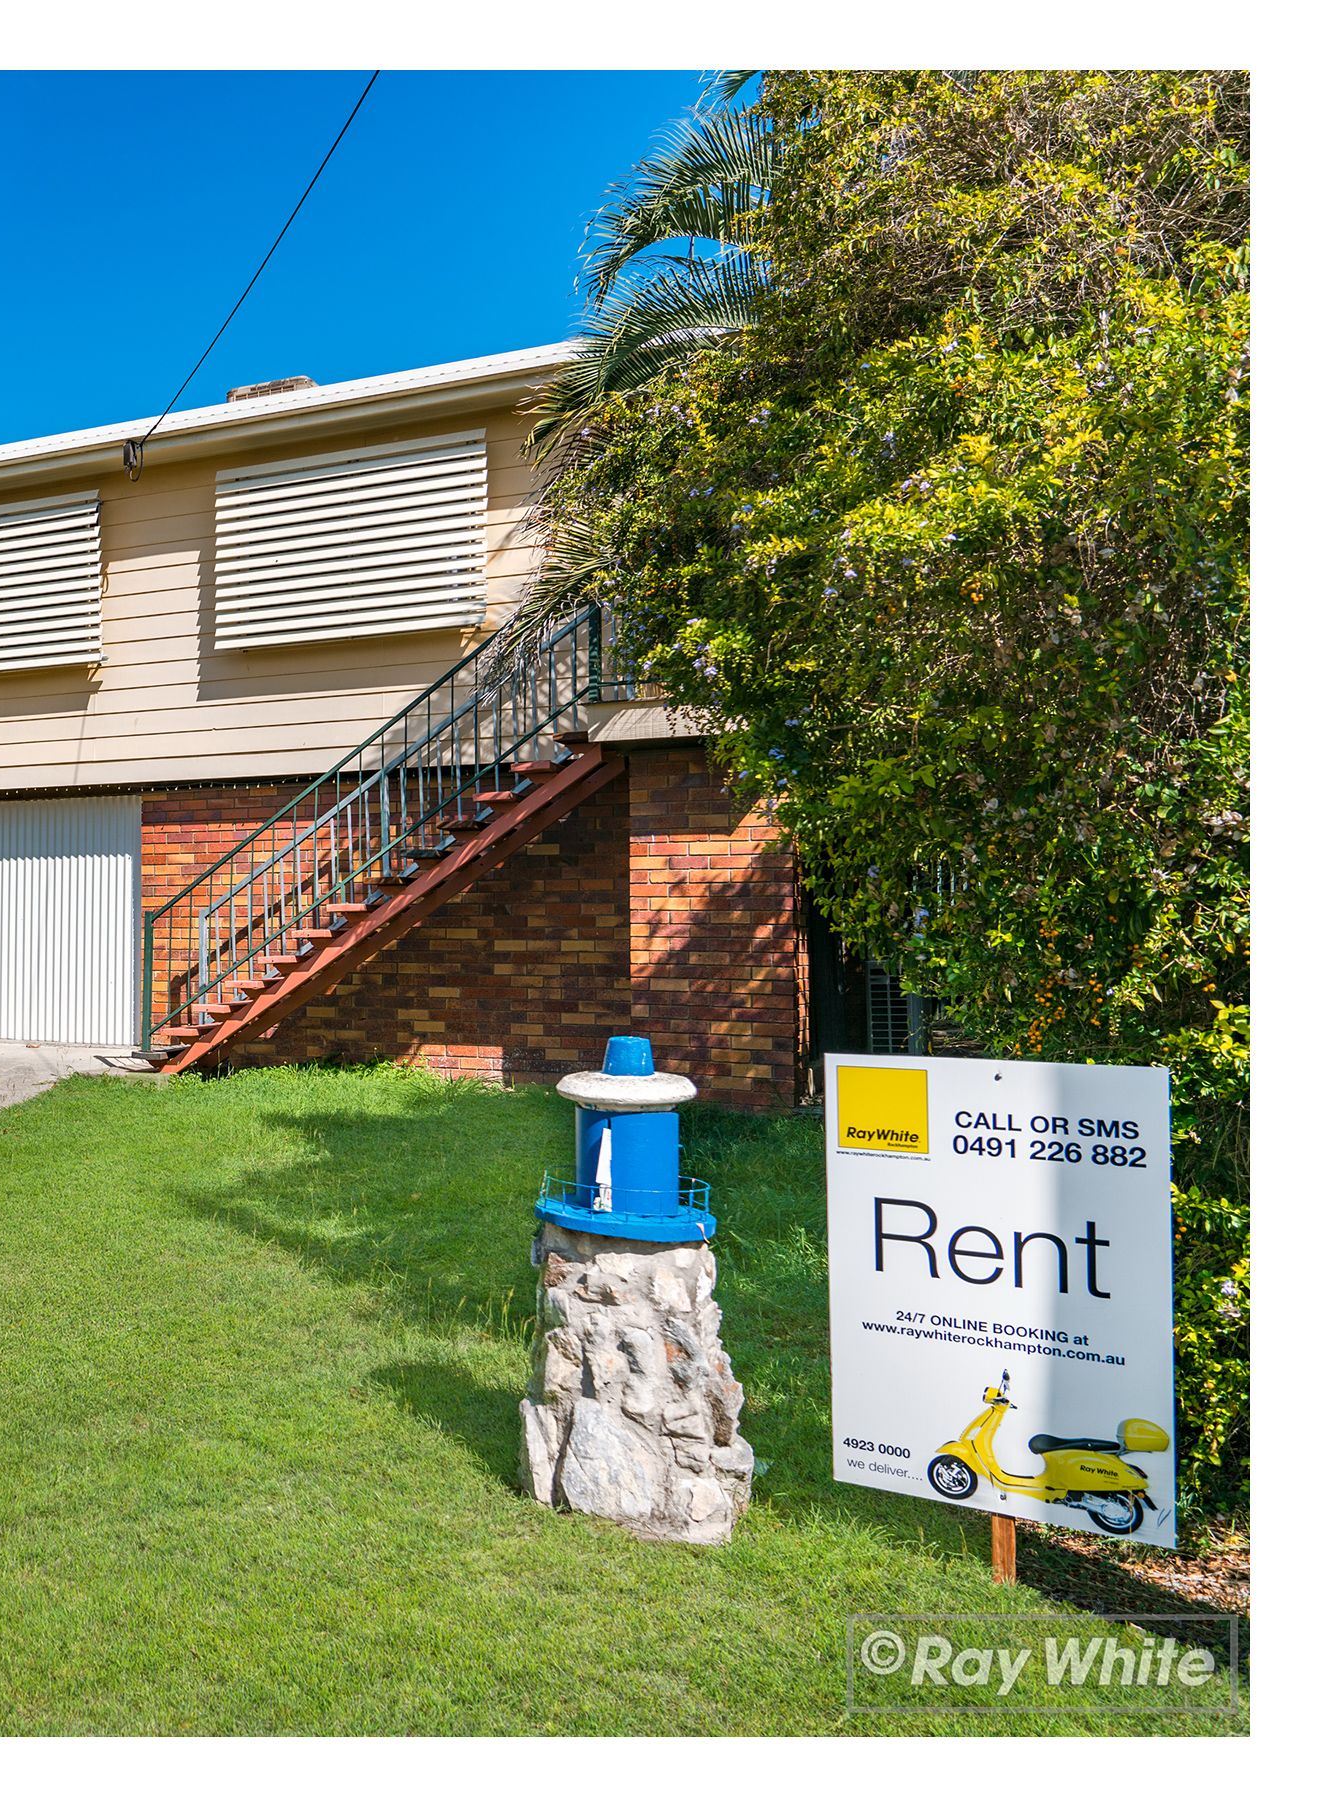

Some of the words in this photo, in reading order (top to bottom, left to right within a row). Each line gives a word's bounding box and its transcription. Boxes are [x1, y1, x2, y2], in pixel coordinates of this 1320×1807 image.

[954, 1111, 1022, 1132] CALL
[1030, 1116, 1069, 1136] OR
[1077, 1118, 1140, 1140] SMS
[952, 1134, 1018, 1158] 0491
[1029, 1140, 1083, 1164] 226
[1091, 1145, 1148, 1168] 882
[874, 1197, 1112, 1300] Rent
[862, 1321, 1126, 1366] www.raywhiterockhampton.com.au
[896, 1310, 926, 1324] 24/7
[930, 1315, 988, 1332] ONLINE
[992, 1323, 1069, 1343] BOOKING
[1073, 1335, 1089, 1346] at
[843, 1437, 875, 1452] 4923
[878, 1443, 911, 1459] 0000
[847, 1458, 865, 1469] we
[1080, 1465, 1095, 1474] Ray
